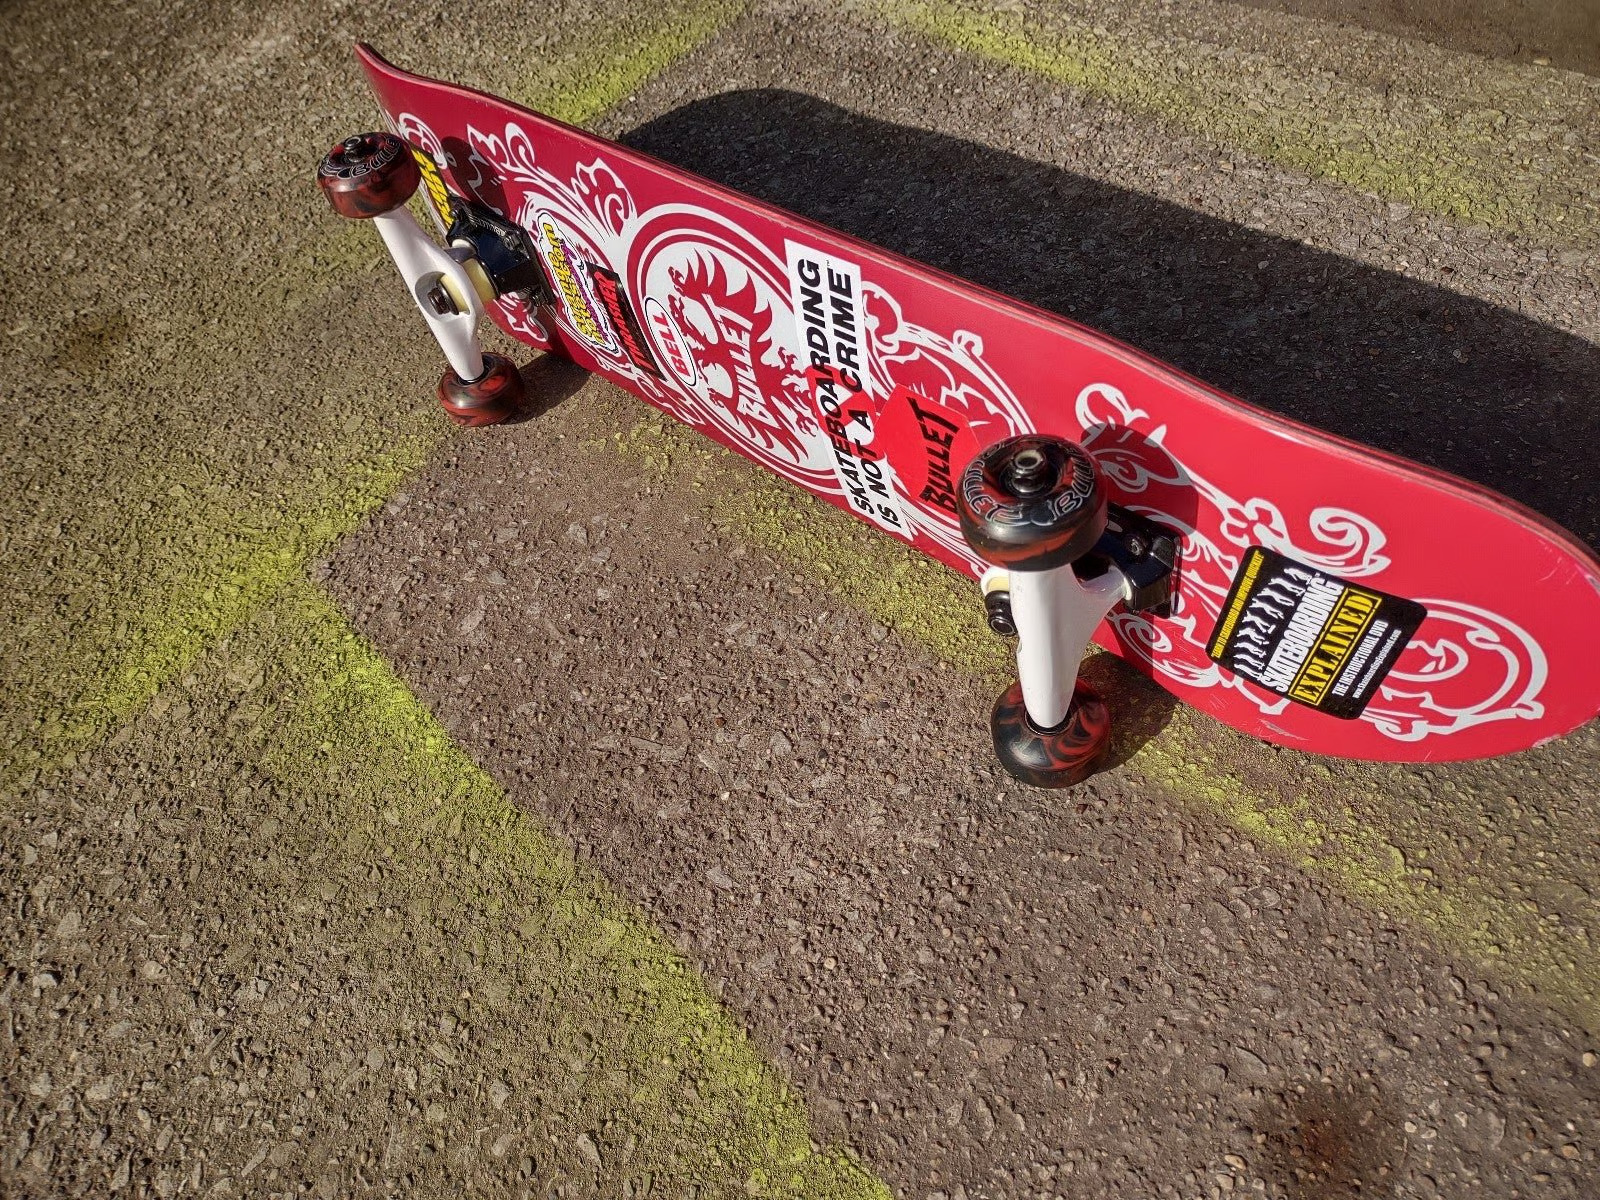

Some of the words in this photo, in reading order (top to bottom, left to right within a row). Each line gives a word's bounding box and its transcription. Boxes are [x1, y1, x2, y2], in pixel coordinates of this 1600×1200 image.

[594, 271, 655, 371] THRASHER
[653, 312, 691, 377] BELL
[702, 293, 782, 430] BULLET
[827, 267, 863, 393] CRIME
[798, 259, 875, 515] SKATEBOARDING
[848, 409, 872, 432] A
[854, 438, 890, 499] NOT
[906, 396, 960, 514] BULLET
[877, 503, 902, 528] IS
[1259, 577, 1344, 693] SKATEBOARDING
[1293, 594, 1373, 702] EXPLAINED
[1338, 634, 1380, 686] INSTRUCTIONAL
[1368, 619, 1389, 638] DVD
[1331, 681, 1351, 697] THE
